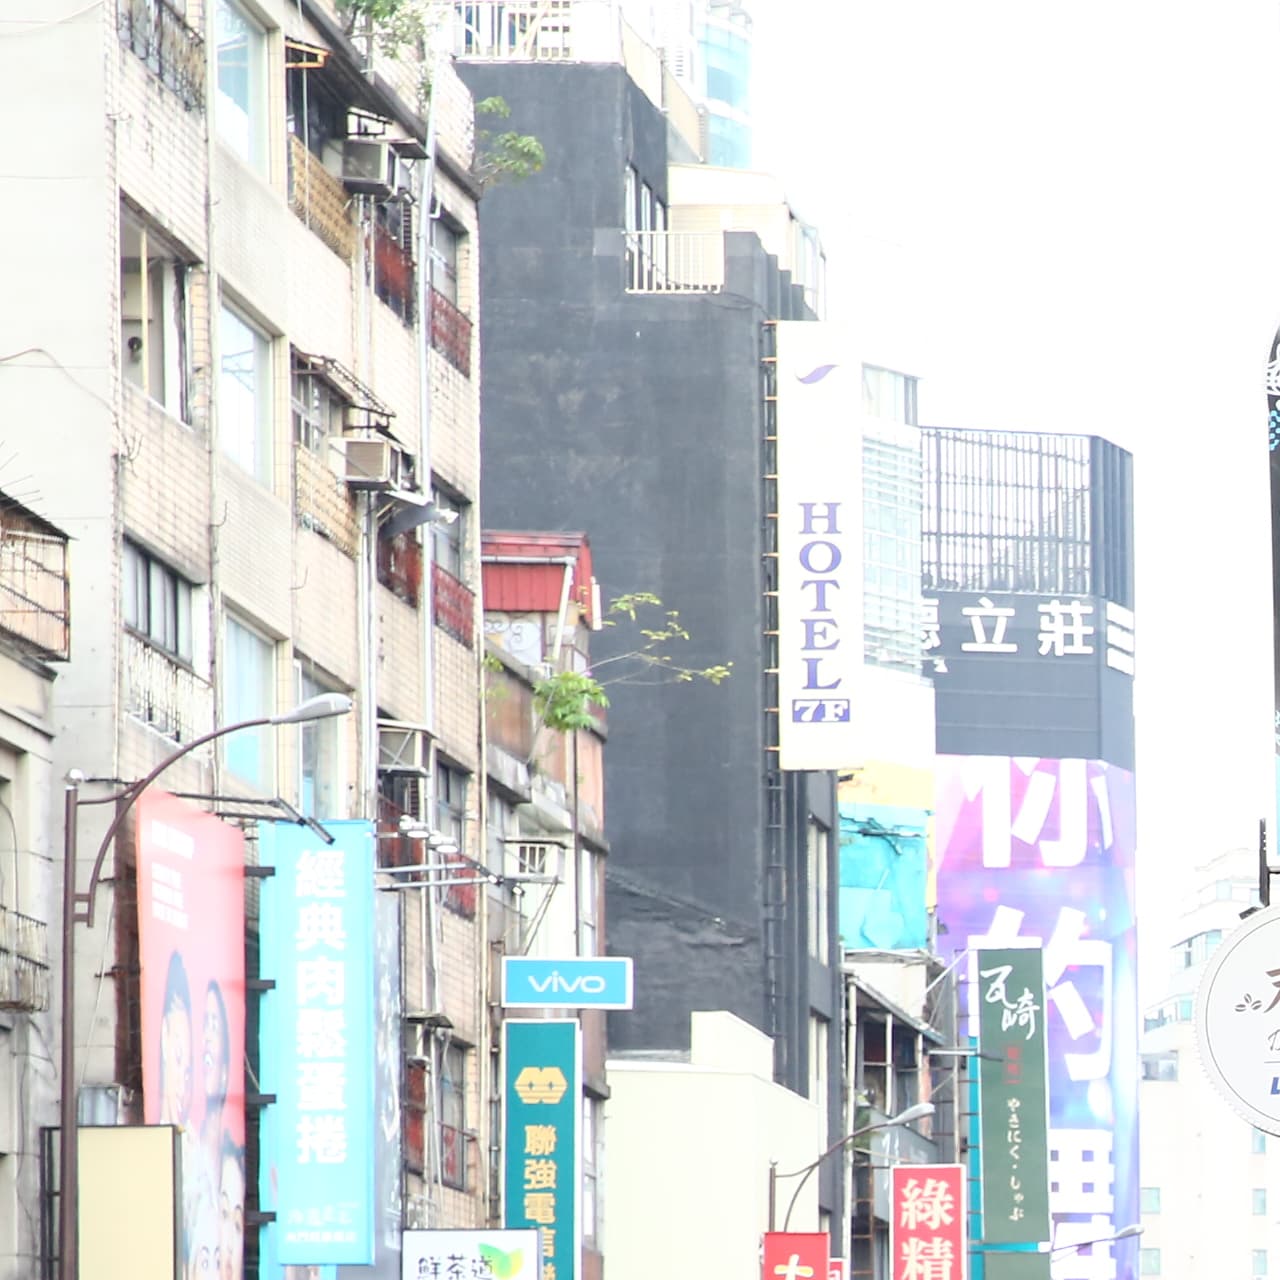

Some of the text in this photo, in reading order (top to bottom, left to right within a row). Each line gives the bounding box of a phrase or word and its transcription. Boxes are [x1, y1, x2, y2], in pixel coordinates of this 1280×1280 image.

[797, 502, 842, 691] HOTEL
[795, 701, 849, 722] 7F
[528, 970, 606, 993] vivo
[417, 1254, 493, 1280] 鮮茶道
